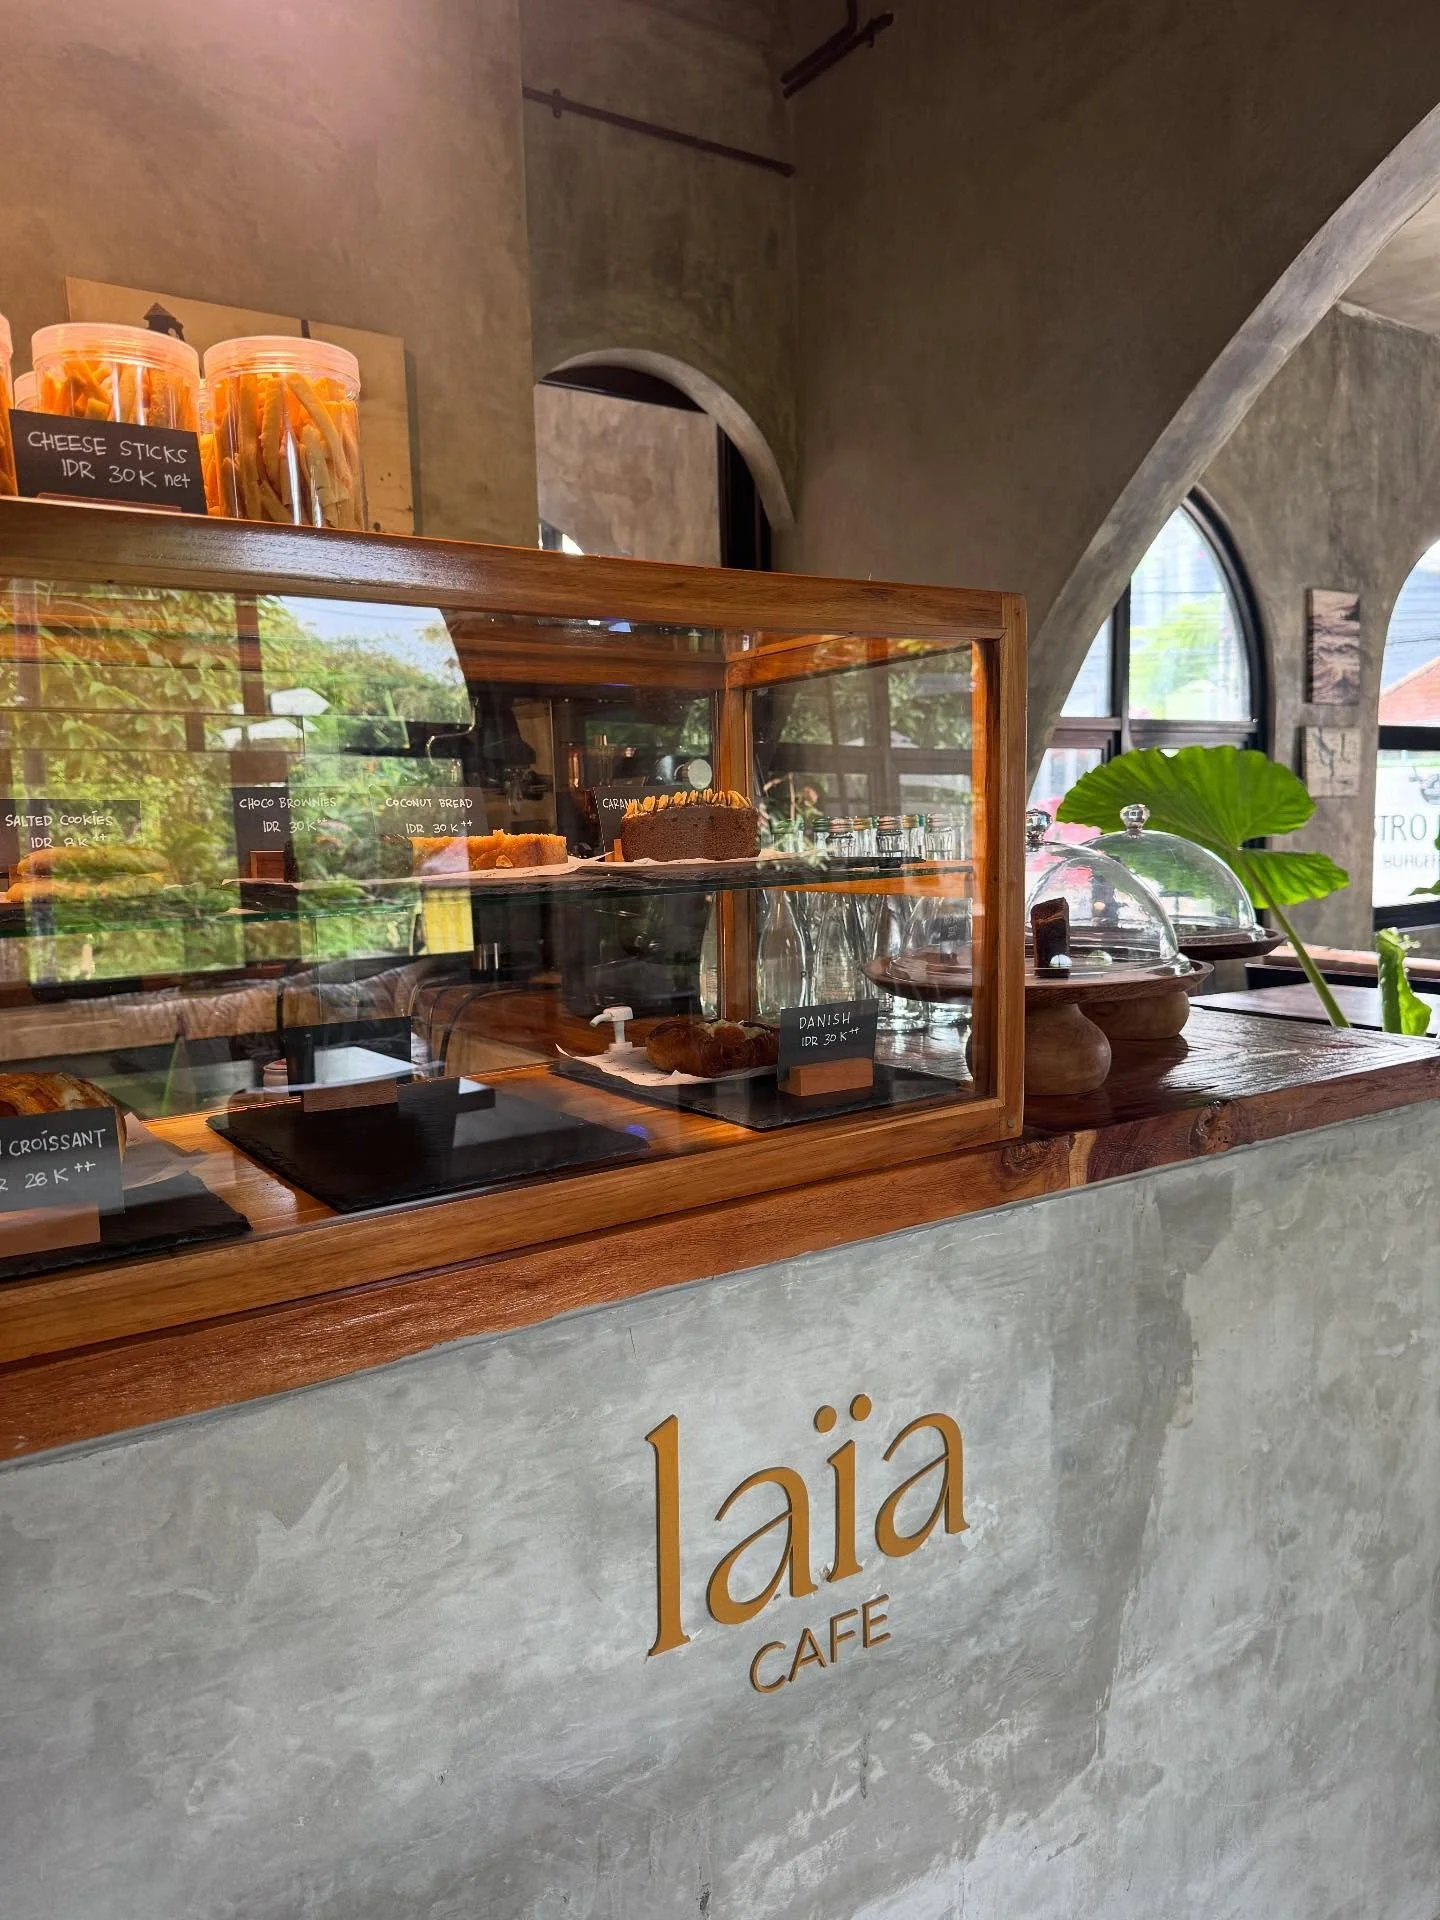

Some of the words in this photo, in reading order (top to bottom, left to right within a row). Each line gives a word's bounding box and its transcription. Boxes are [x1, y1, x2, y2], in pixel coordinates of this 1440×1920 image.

[27, 431, 108, 456] CHEESE
[119, 440, 188, 464] STICKS
[61, 458, 96, 480] IDR
[164, 472, 191, 489] net
[238, 797, 275, 810] CHOCO
[385, 797, 432, 808] COCONUT
[438, 798, 473, 809] BREAD
[4, 814, 53, 828] SALTED
[262, 820, 281, 833] IDR
[1377, 814, 1427, 841] TRO
[405, 823, 425, 834] IDR
[30, 837, 54, 849] IDR
[799, 1011, 851, 1030] DANISH
[801, 1036, 819, 1047] IDR
[750, 1594, 891, 1693] CAFE
